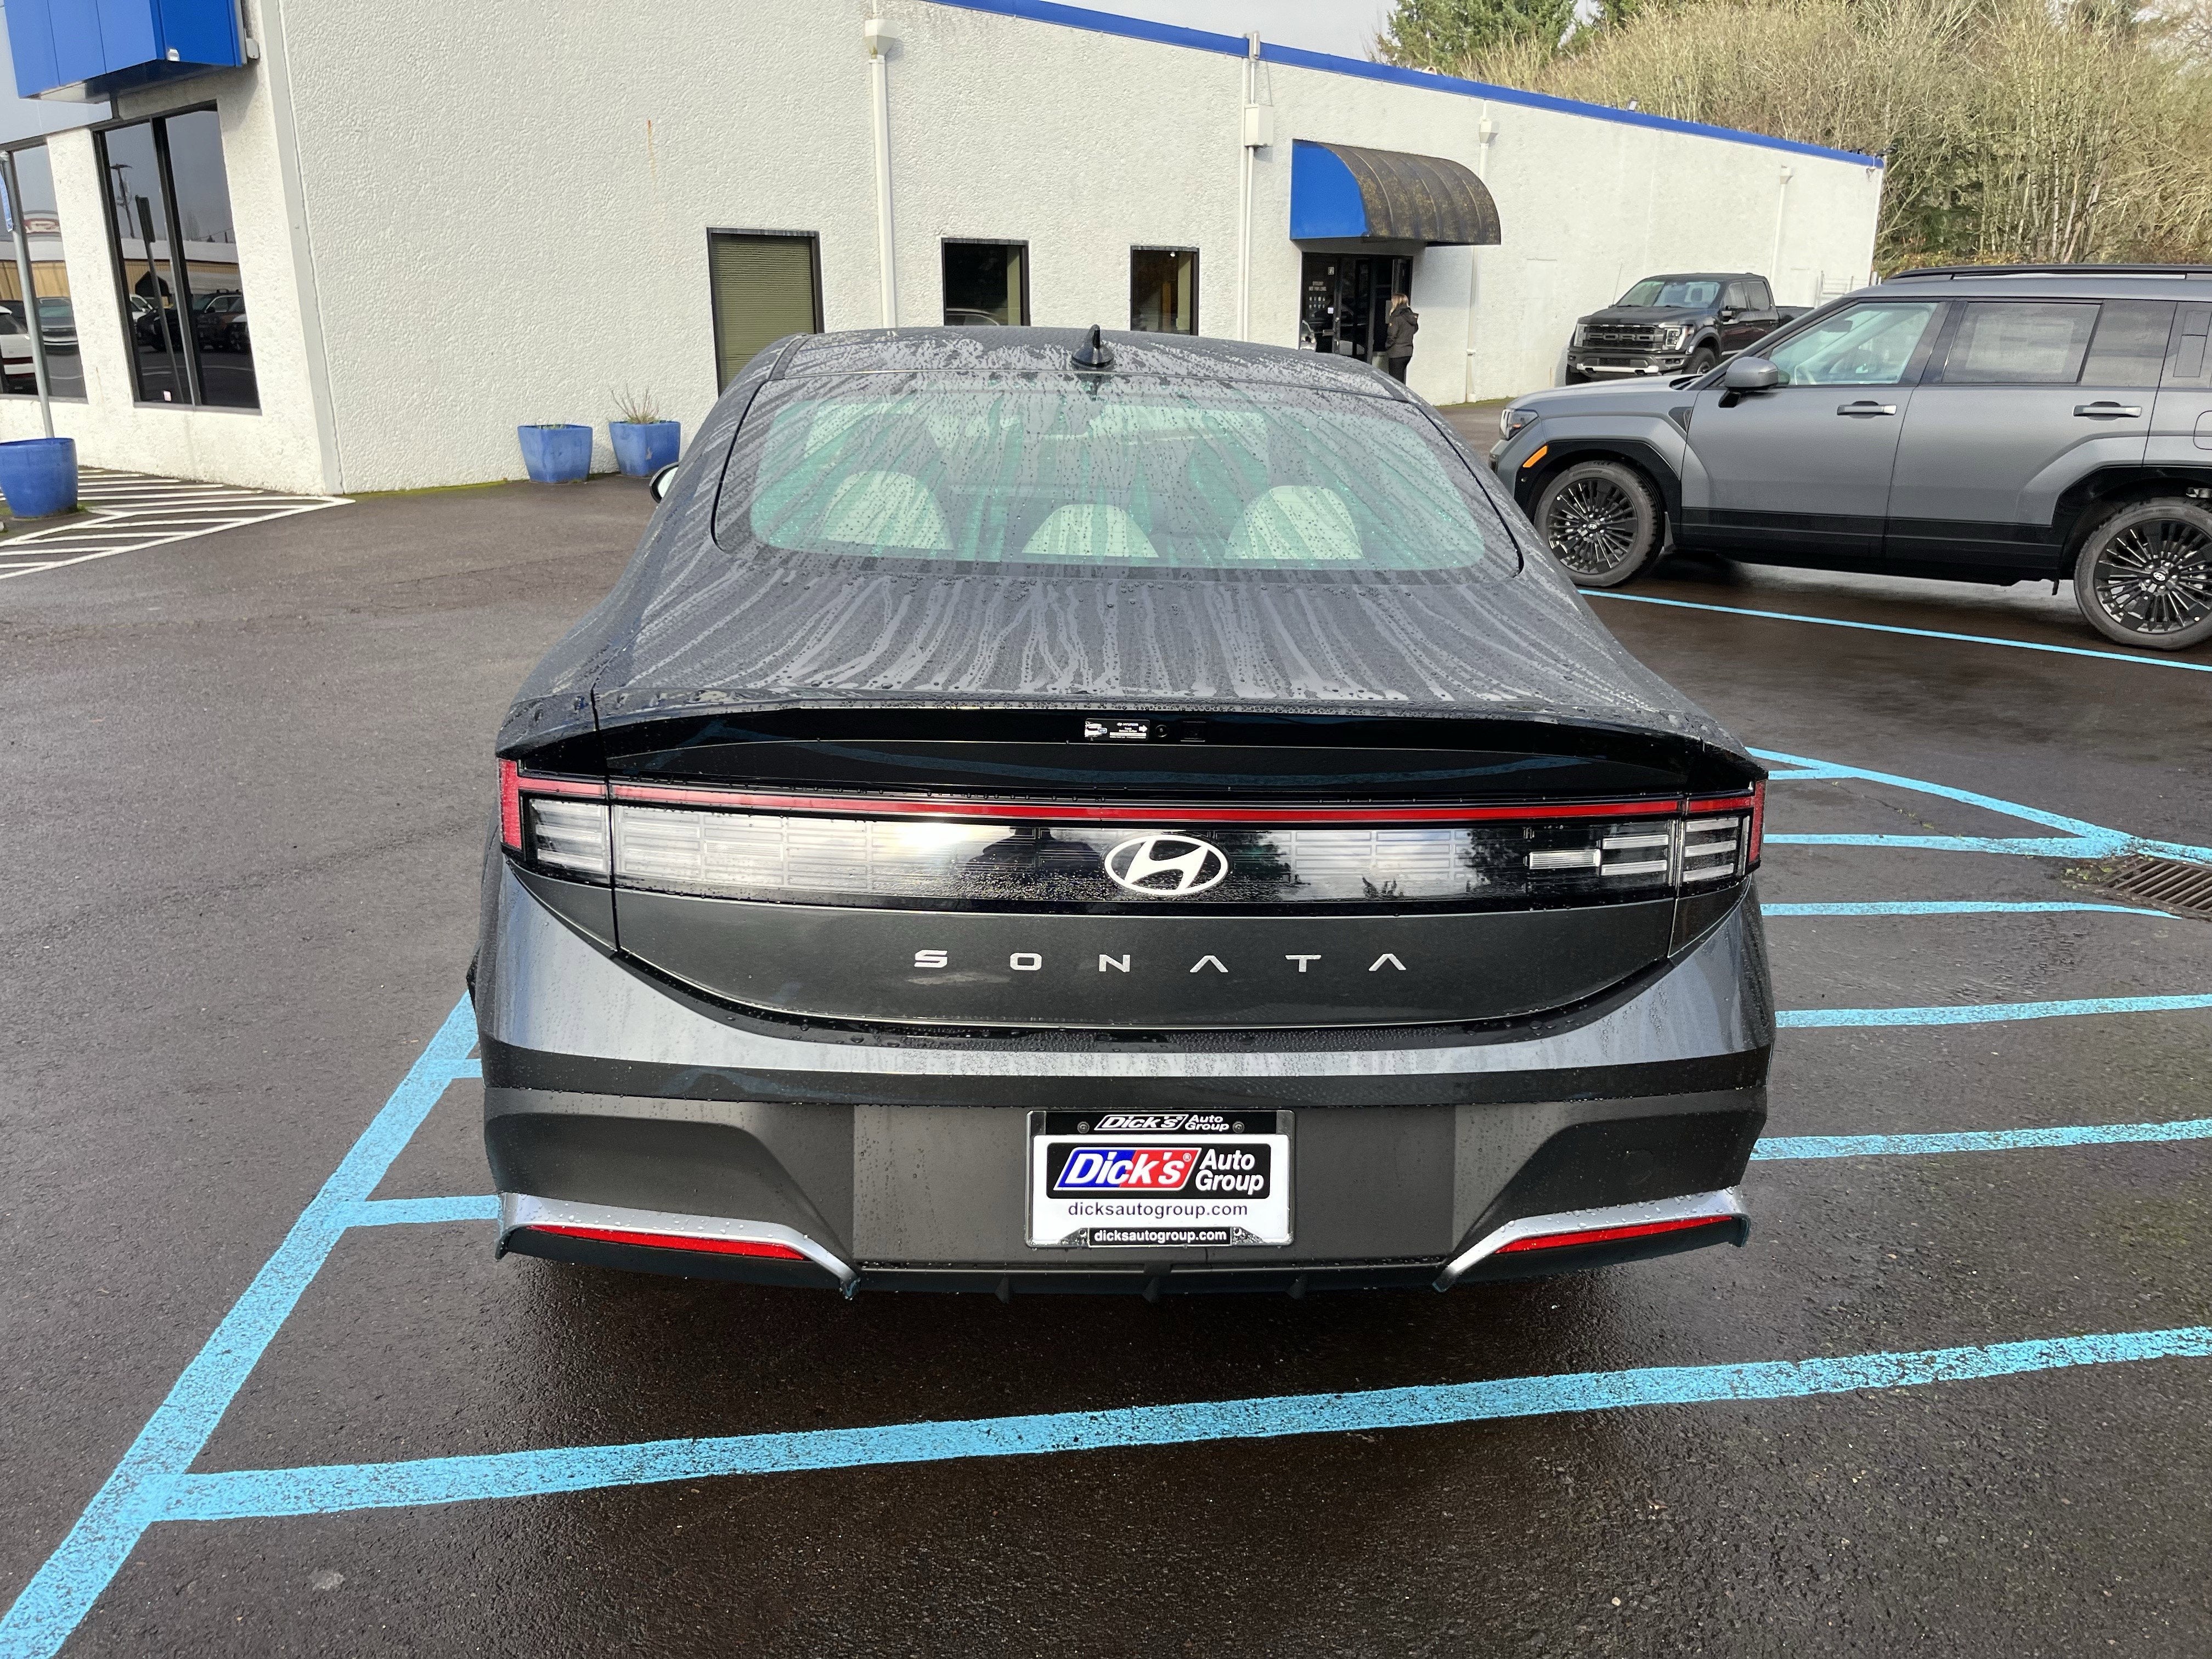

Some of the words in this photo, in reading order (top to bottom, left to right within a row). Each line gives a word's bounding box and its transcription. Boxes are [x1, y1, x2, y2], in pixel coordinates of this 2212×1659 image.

[1589, 332, 1655, 341] FORD
[913, 950, 1406, 973] SONATA
[1101, 1116, 1178, 1128] Dick's
[1188, 1114, 1223, 1123] Auto
[1184, 1121, 1229, 1132] Group
[1199, 1148, 1255, 1170] Auto
[1065, 1151, 1186, 1184] Dick's
[1195, 1169, 1265, 1195] Group
[1068, 1202, 1248, 1218] dicksautogroup.com
[1094, 1229, 1227, 1243] dicksautogroup.com
